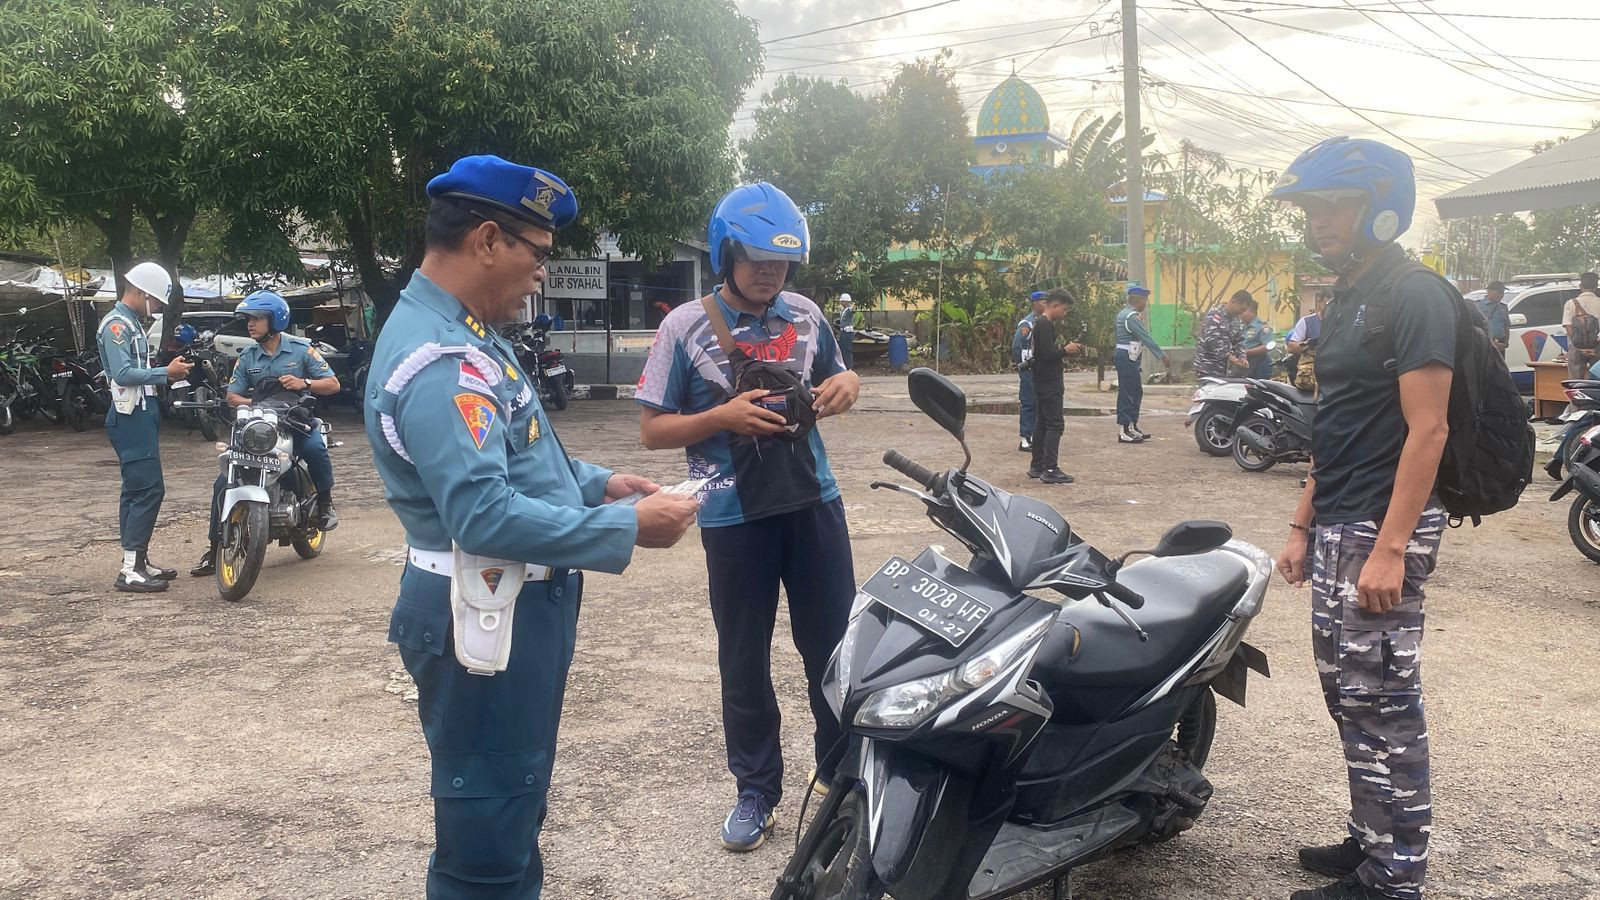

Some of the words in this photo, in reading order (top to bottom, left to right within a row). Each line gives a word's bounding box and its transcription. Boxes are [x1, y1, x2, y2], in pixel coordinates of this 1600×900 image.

[548, 265, 583, 274] LANAL
[584, 266, 601, 275] BIN
[549, 277, 564, 289] UR
[566, 277, 604, 290] SYAHAL
[1026, 511, 1059, 535] HONDA
[882, 560, 910, 579] BP
[911, 577, 958, 609] 3028
[956, 600, 987, 622] WF
[971, 710, 1009, 731] HONDA
